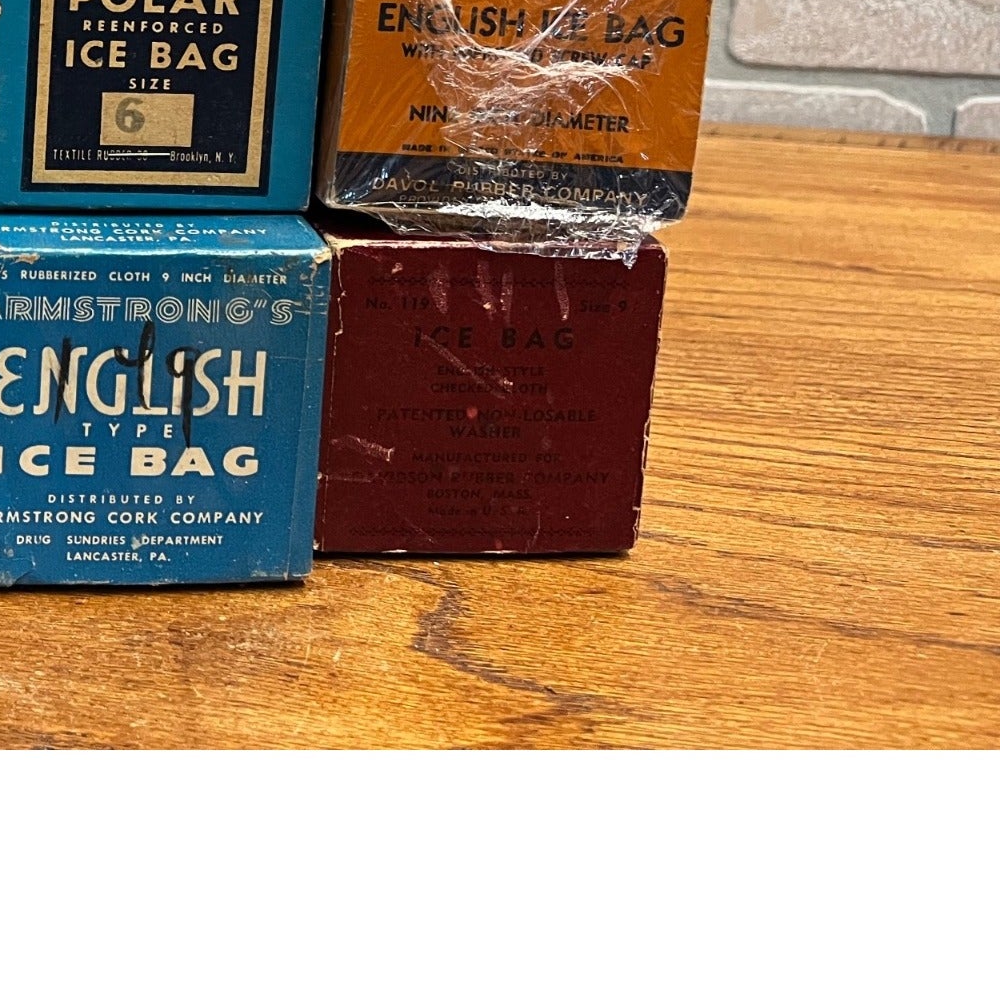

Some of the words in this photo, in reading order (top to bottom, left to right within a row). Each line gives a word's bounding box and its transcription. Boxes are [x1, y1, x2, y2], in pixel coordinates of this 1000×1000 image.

[82, 20, 224, 35] REENFORCED
[377, 3, 525, 37] ENGLISH
[605, 14, 685, 47] BAG
[65, 40, 126, 69] ICE
[150, 41, 239, 71] BAG
[129, 78, 171, 90] SIZE
[115, 97, 145, 134] 6
[530, 112, 629, 133] DIAMETER
[53, 150, 91, 160] TEXTILE
[170, 151, 211, 164] Brooklyn,
[372, 177, 440, 192] DAVOL
[20, 270, 96, 280] RUBBERIZED
[110, 272, 150, 282] CLOTH
[162, 273, 170, 282] 9
[182, 273, 212, 282] INCH
[224, 274, 286, 284] DIAMETER
[401, 298, 430, 309] 119
[415, 327, 473, 348] ICE
[502, 328, 574, 350] BAG
[83, 423, 173, 438] TYPE
[131, 447, 259, 476] BAG
[48, 495, 163, 504] DISTRIBUTED
[176, 495, 195, 504] BY
[108, 511, 157, 524] CORK
[171, 511, 264, 524] COMPANY
[17, 535, 51, 545] DRUG
[66, 535, 126, 545] SUNDRIES
[142, 535, 223, 545] DEPARTMENT
[66, 552, 143, 562] LANCASTER,
[150, 552, 171, 562] PA.
